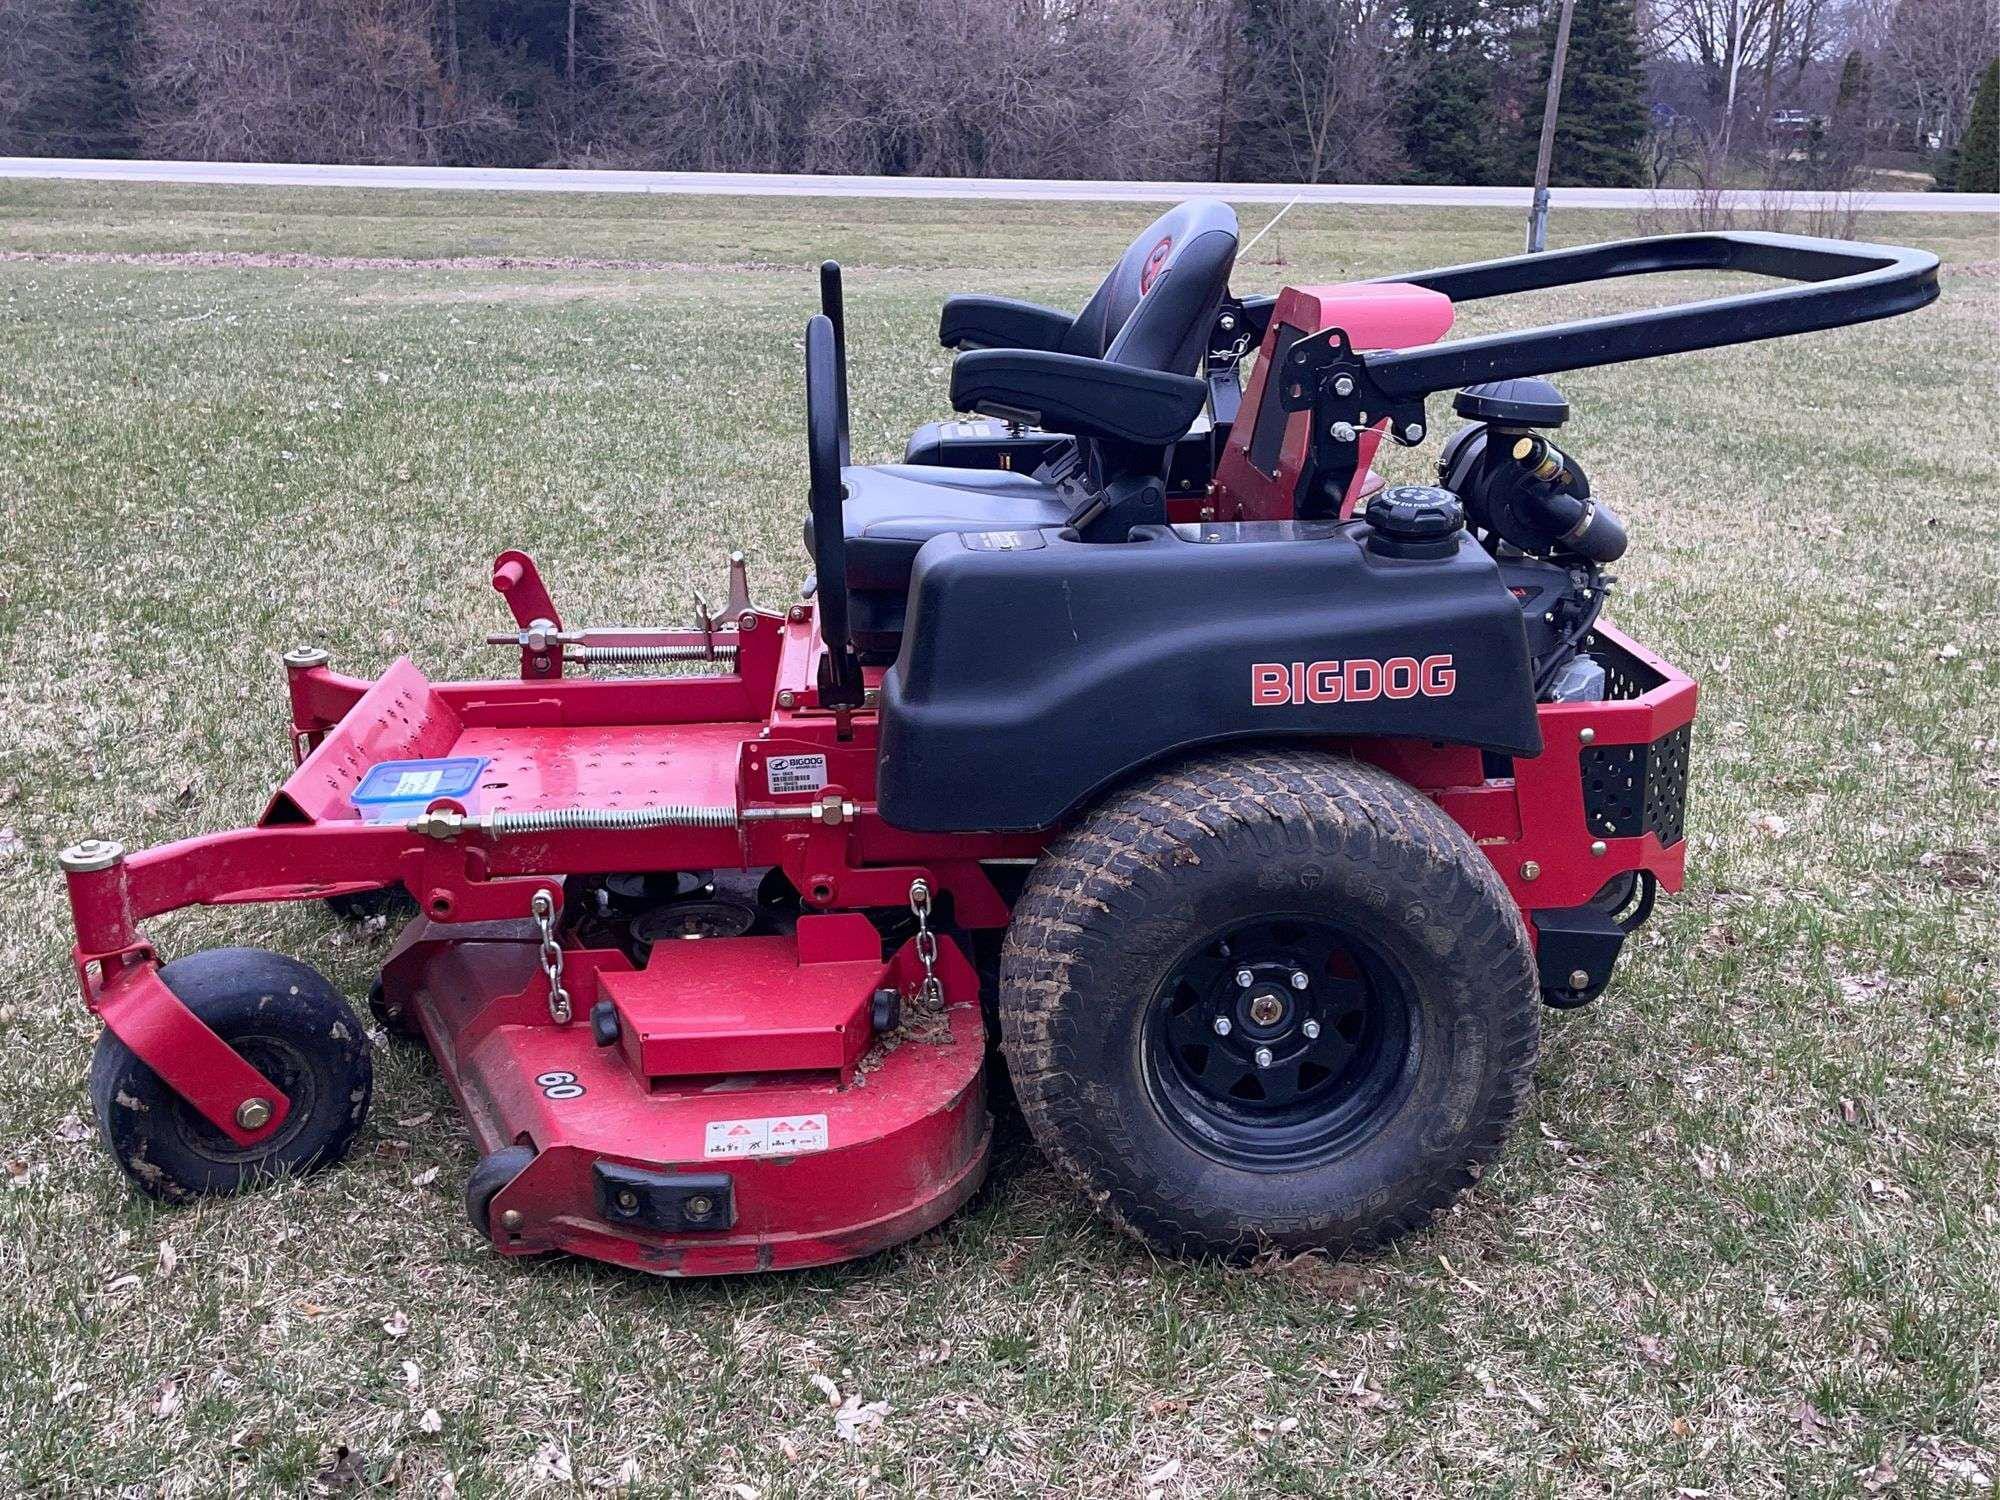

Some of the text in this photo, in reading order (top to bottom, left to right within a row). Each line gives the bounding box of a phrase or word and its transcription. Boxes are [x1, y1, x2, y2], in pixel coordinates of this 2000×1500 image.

[1252, 655, 1456, 706] BIGDOG
[790, 757, 823, 766] BIGDOG
[535, 1071, 587, 1099] 60
